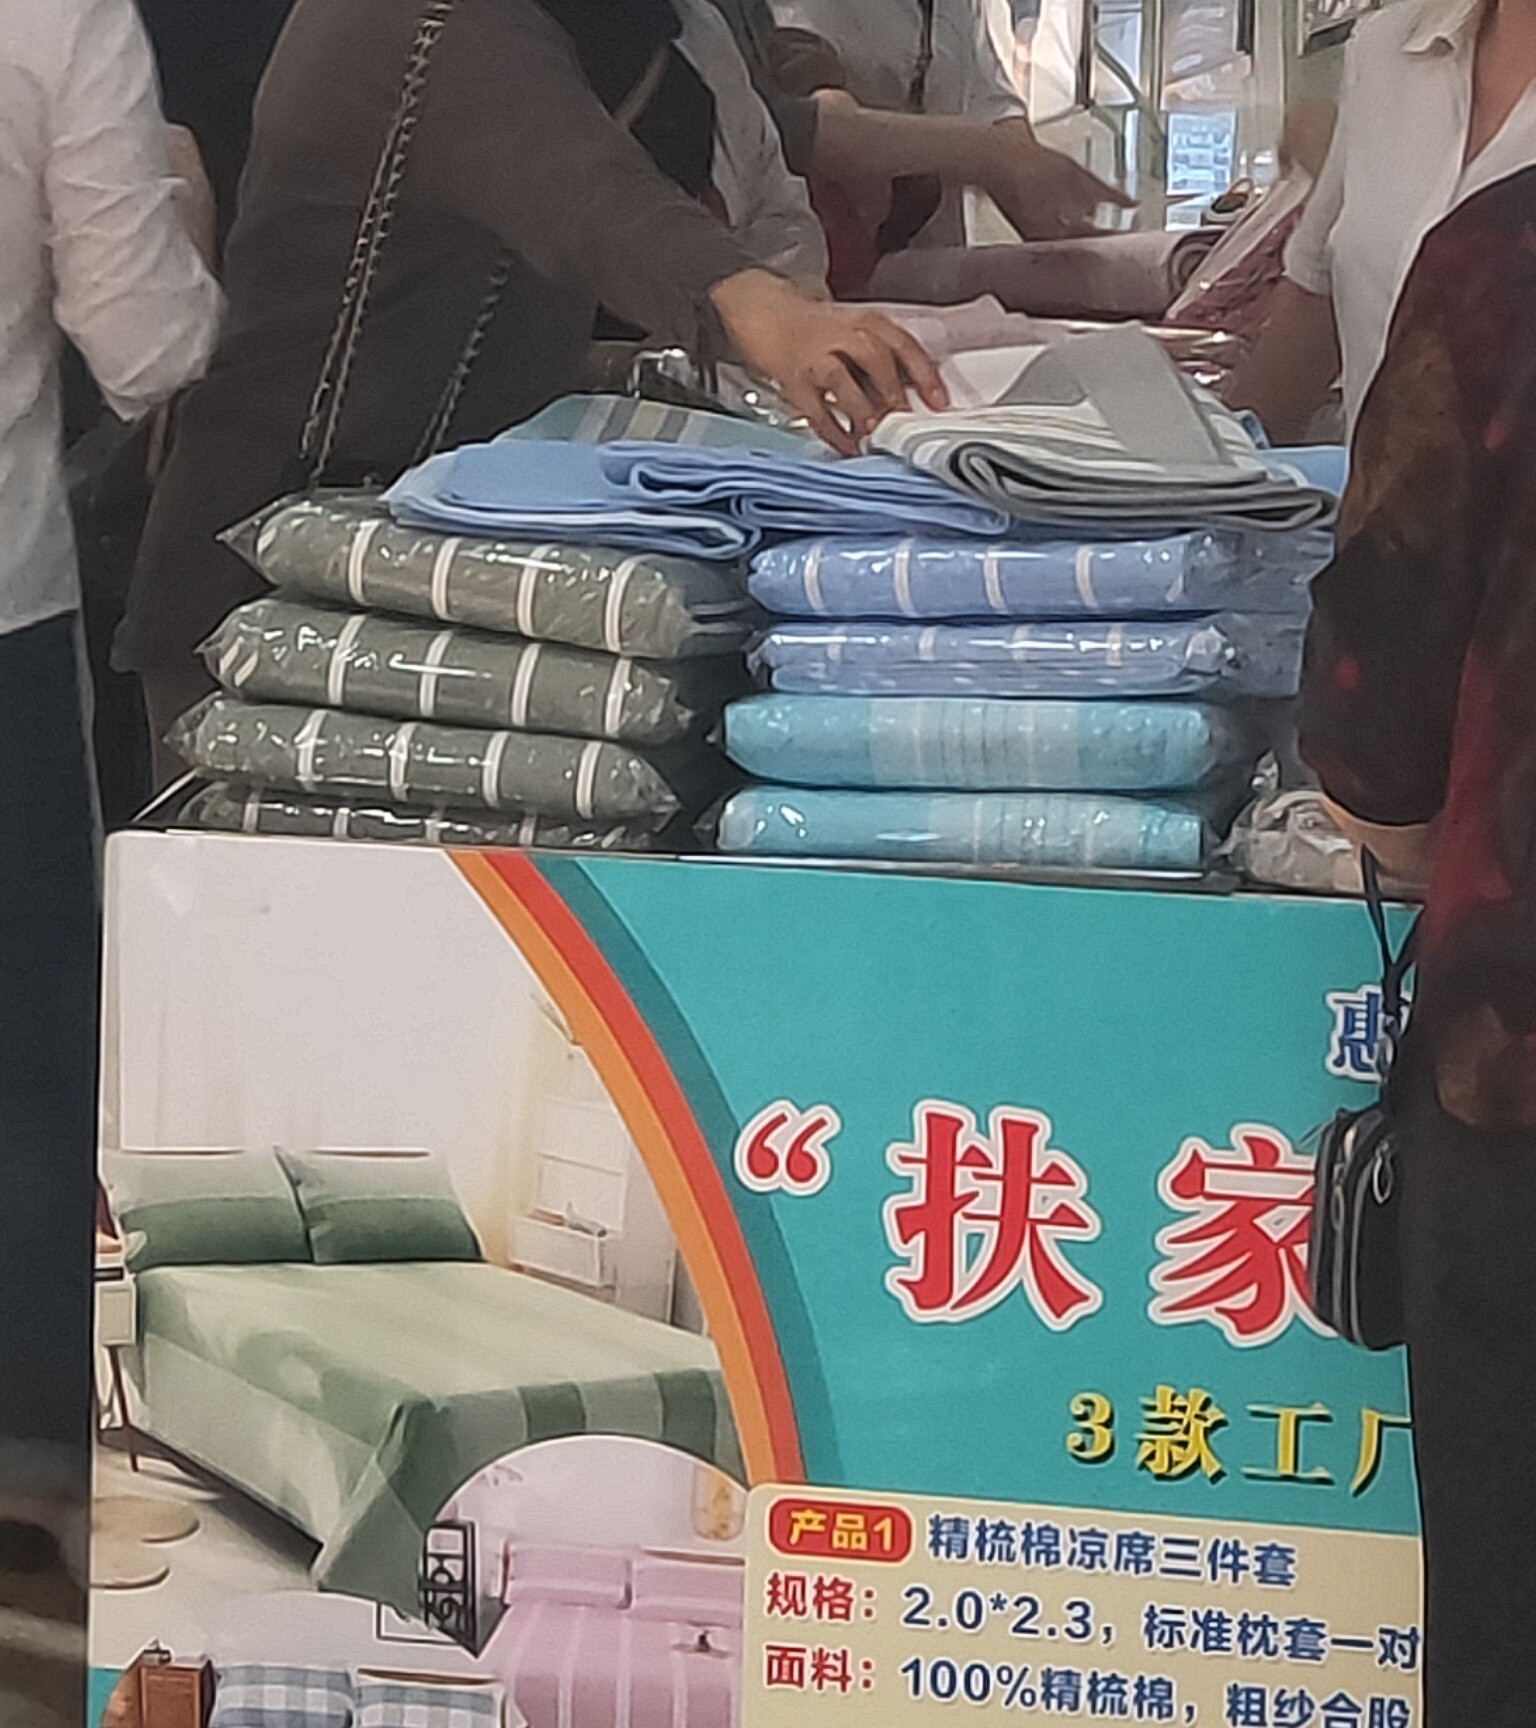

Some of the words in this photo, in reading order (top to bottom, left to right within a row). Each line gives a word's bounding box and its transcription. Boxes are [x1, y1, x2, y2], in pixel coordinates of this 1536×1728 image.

[788, 1508, 894, 1552] 产品1
[927, 1512, 1297, 1587] 精梳棉凉席三件套
